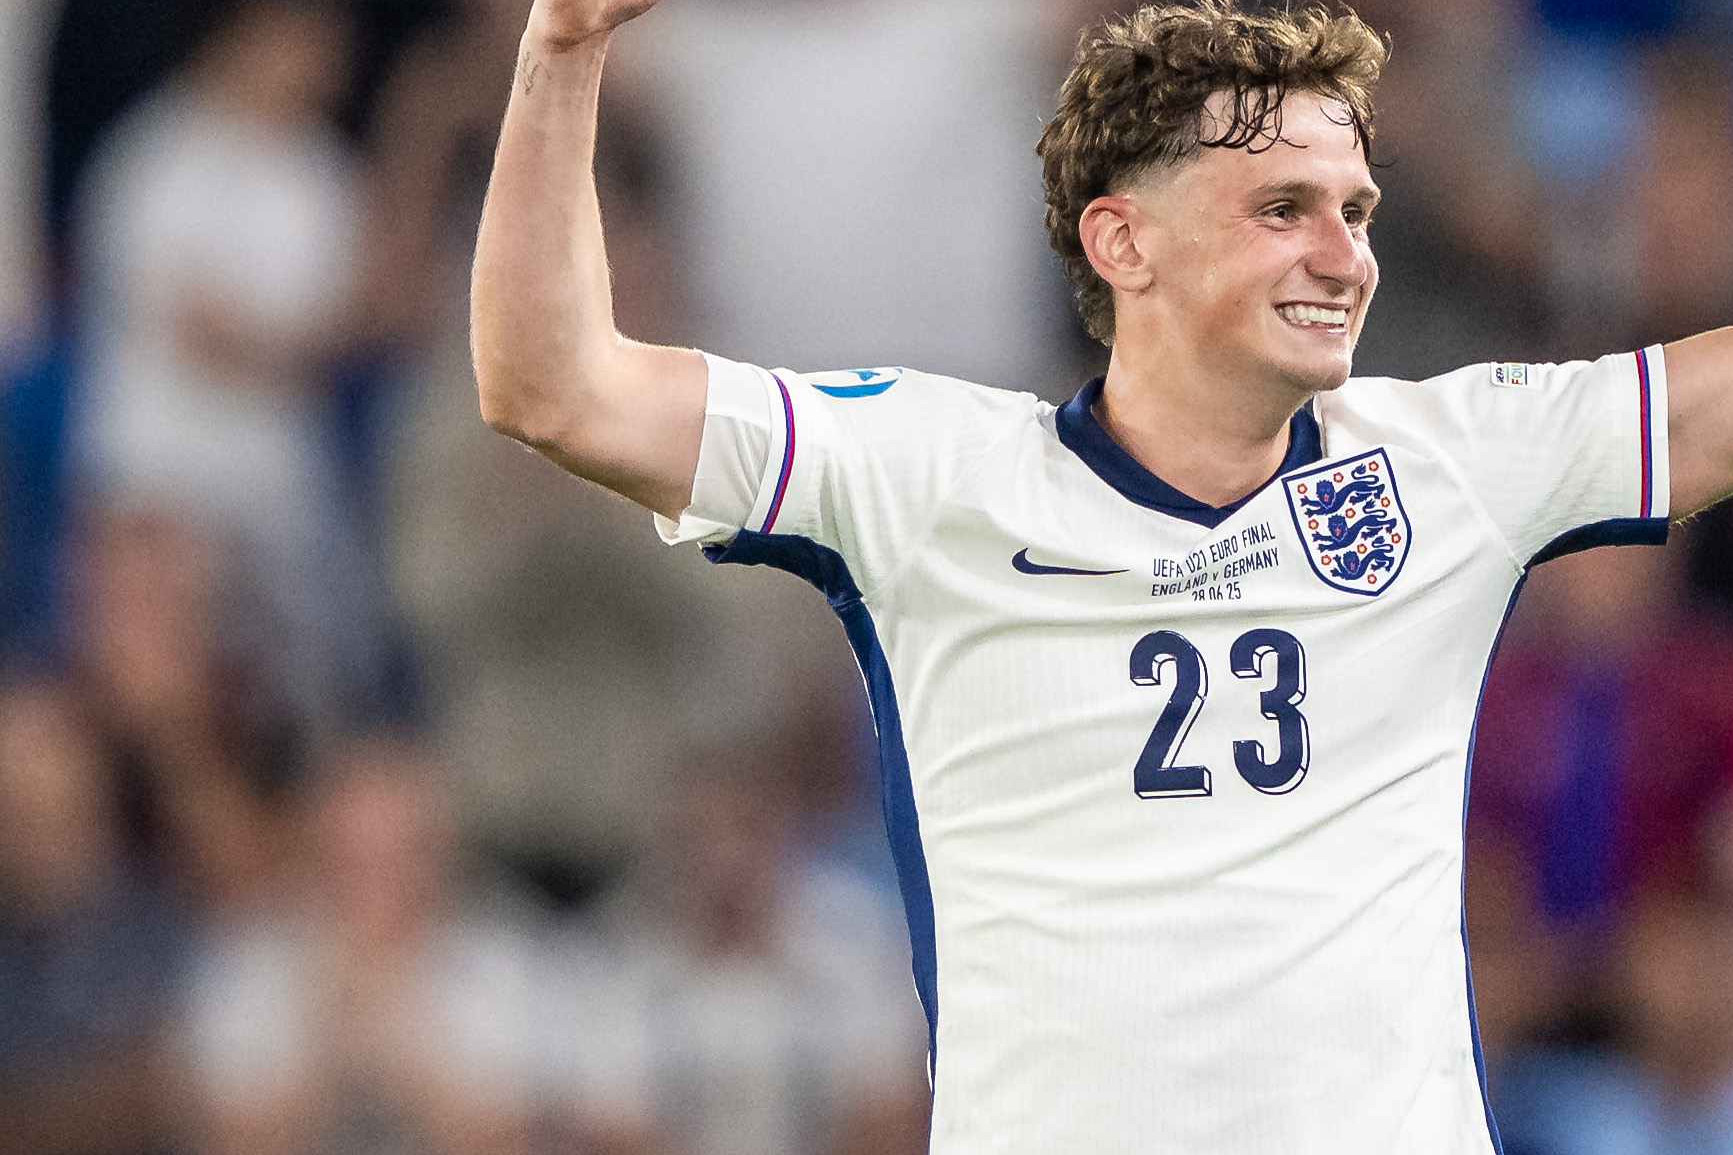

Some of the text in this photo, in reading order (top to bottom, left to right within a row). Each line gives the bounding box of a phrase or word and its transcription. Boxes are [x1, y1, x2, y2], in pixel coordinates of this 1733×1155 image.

[1151, 572, 1208, 597] ENGLAND
[1223, 547, 1280, 579] GERMANY
[1153, 522, 1276, 578] UEFA U21 EURO FINAL
[1129, 628, 1311, 800] 23
